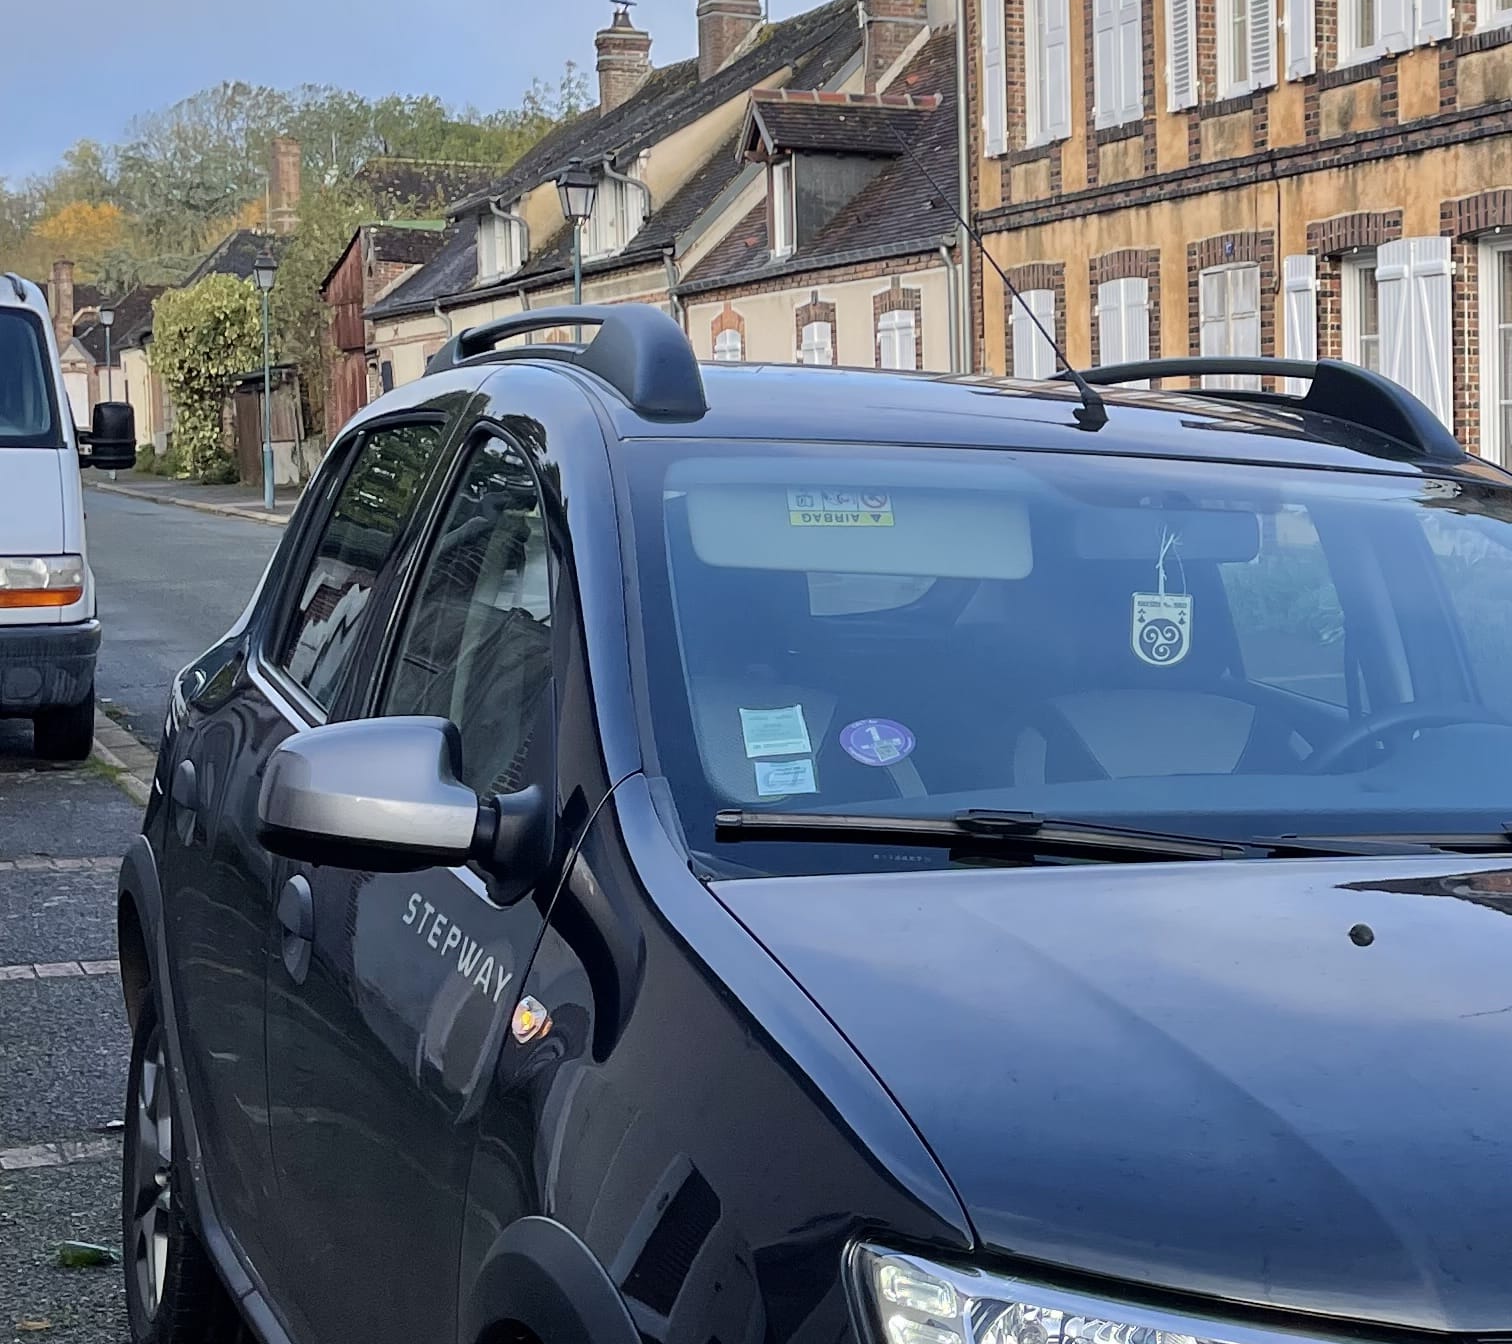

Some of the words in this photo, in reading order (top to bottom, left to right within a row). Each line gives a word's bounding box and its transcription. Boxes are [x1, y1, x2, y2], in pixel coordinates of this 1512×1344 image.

[801, 513, 860, 524] AIRBAG
[865, 726, 881, 742] 1
[402, 892, 513, 1003] STEPWAY
